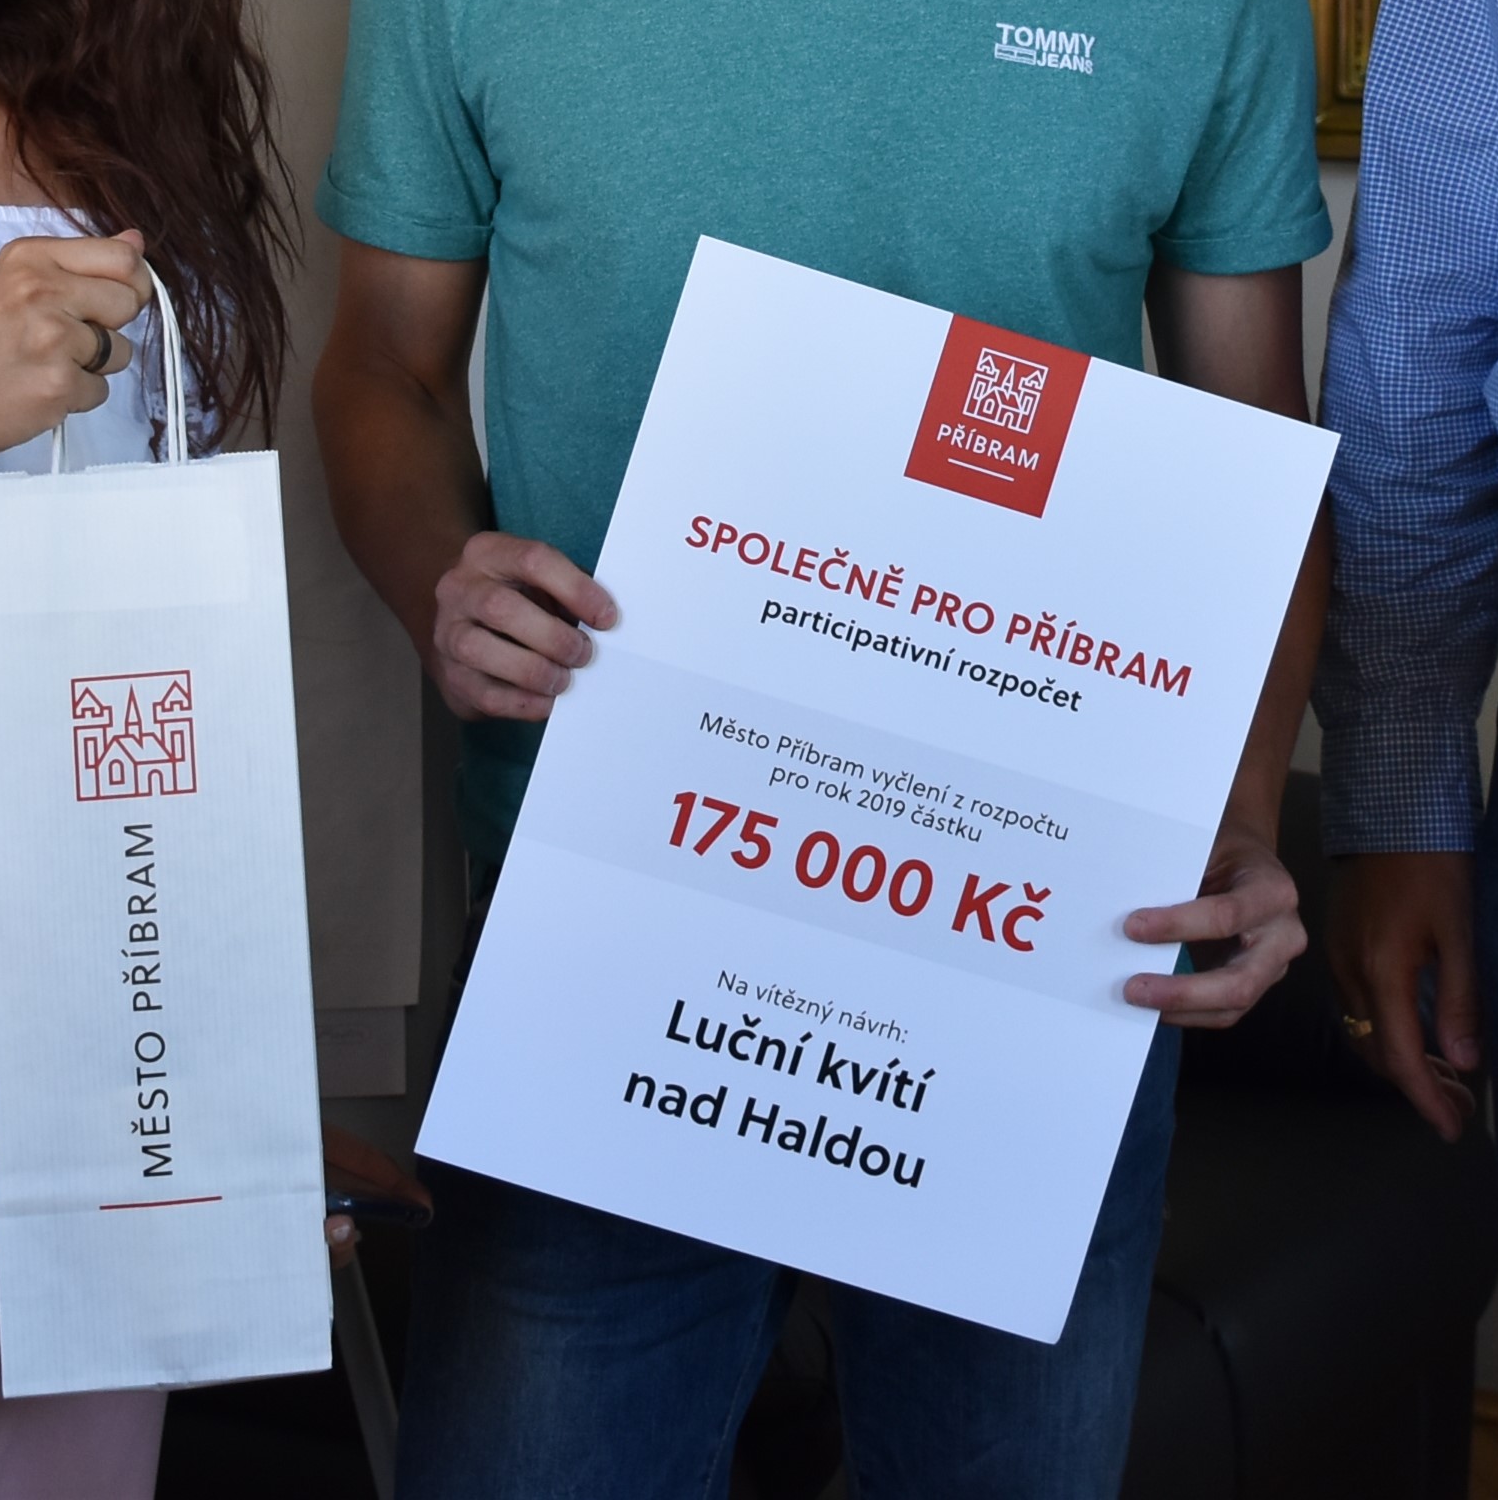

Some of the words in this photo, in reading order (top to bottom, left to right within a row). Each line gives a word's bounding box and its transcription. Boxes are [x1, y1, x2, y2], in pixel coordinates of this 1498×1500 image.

[995, 22, 1096, 58] TOMMY
[1036, 52, 1094, 74] JEANS
[936, 422, 1040, 471] PŘÍBRAM
[684, 515, 906, 609] SPOLEČNĚ
[909, 583, 996, 635] PRO
[1004, 610, 1193, 698] PŘÍBRAM
[759, 599, 957, 673] participativní
[957, 659, 1083, 713] rozpočet
[699, 711, 770, 750] Město
[775, 734, 865, 780] Příbram
[872, 768, 952, 805] vyčlení
[952, 793, 966, 810] z
[969, 799, 1070, 842] rozpočtu
[768, 766, 810, 790] pro
[814, 779, 853, 804] rok
[855, 788, 906, 819] 2019
[910, 803, 983, 843] částku
[121, 823, 163, 1012] PŘÍBRAM
[668, 790, 780, 870] 175
[794, 830, 934, 918] 000
[950, 872, 1053, 953] Kč
[665, 998, 814, 1077] Luční
[815, 1040, 937, 1114] kvítí
[716, 969, 749, 997] Na
[756, 983, 835, 1026] vítězný
[837, 1010, 909, 1044] návrh:
[130, 1030, 173, 1178] MĚSTO
[622, 1071, 729, 1129] nad
[736, 1096, 926, 1189] Haldou
